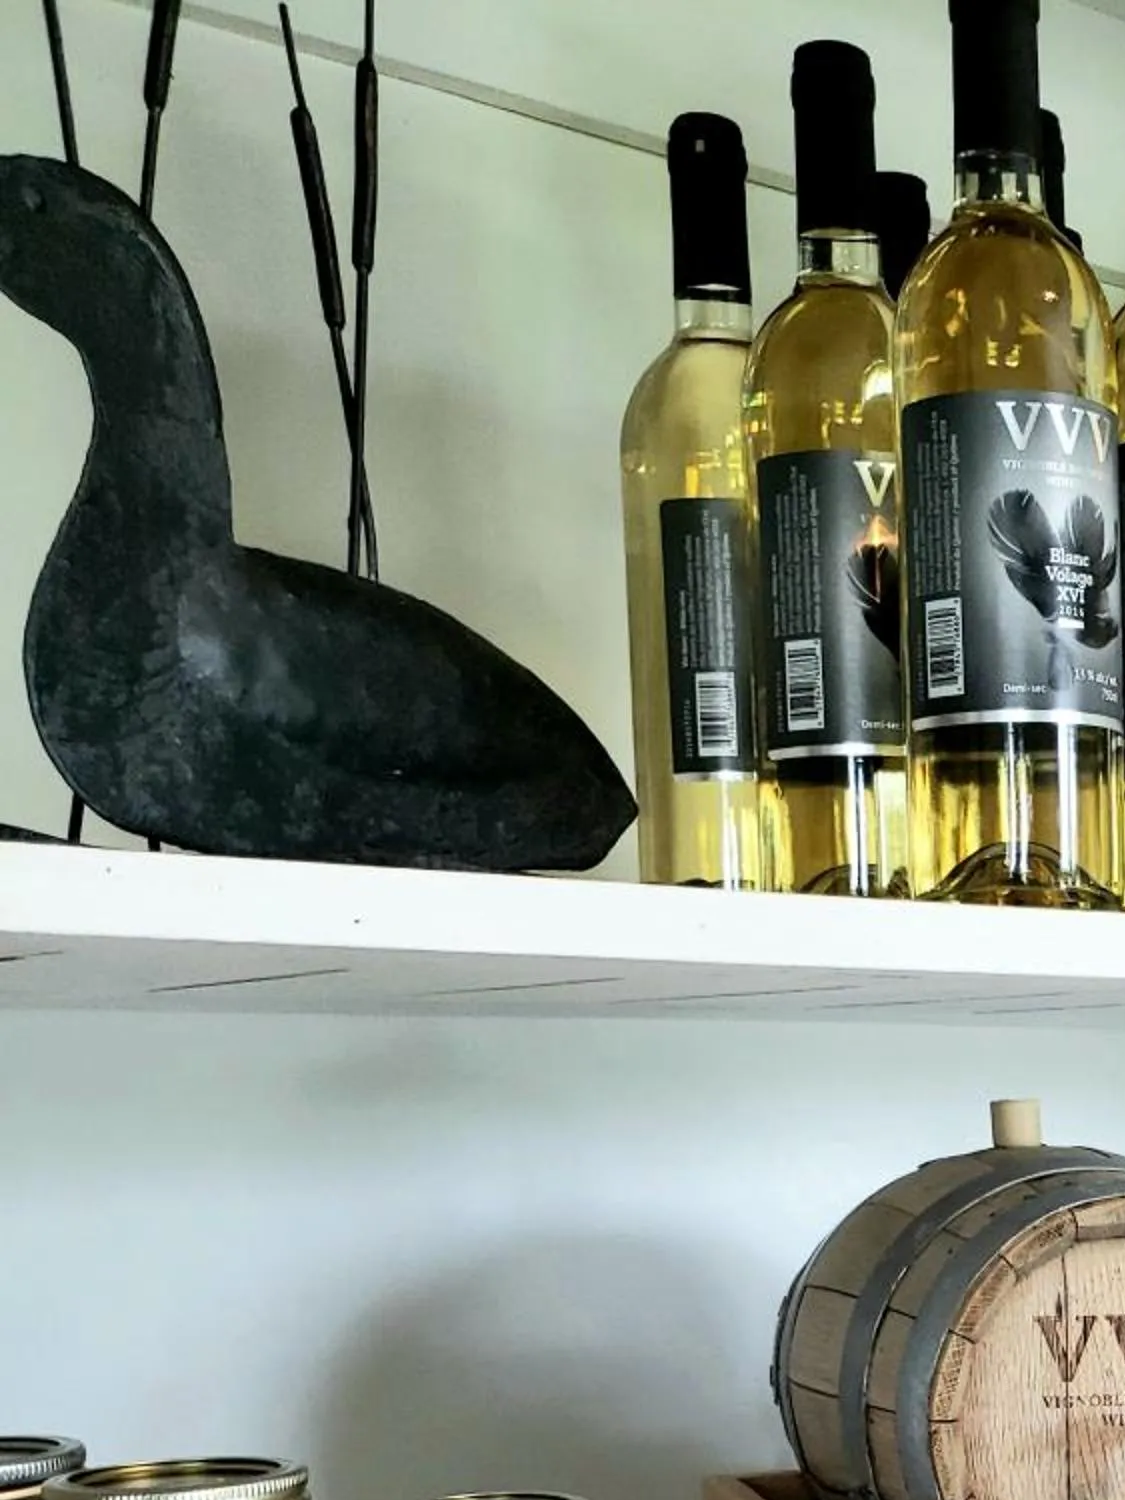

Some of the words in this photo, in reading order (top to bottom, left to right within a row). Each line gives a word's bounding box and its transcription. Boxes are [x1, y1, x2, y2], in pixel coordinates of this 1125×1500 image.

[995, 401, 1111, 464] VVV
[1049, 547, 1091, 567] Blanc
[1044, 565, 1094, 588] Volage
[1056, 585, 1085, 604] XVI
